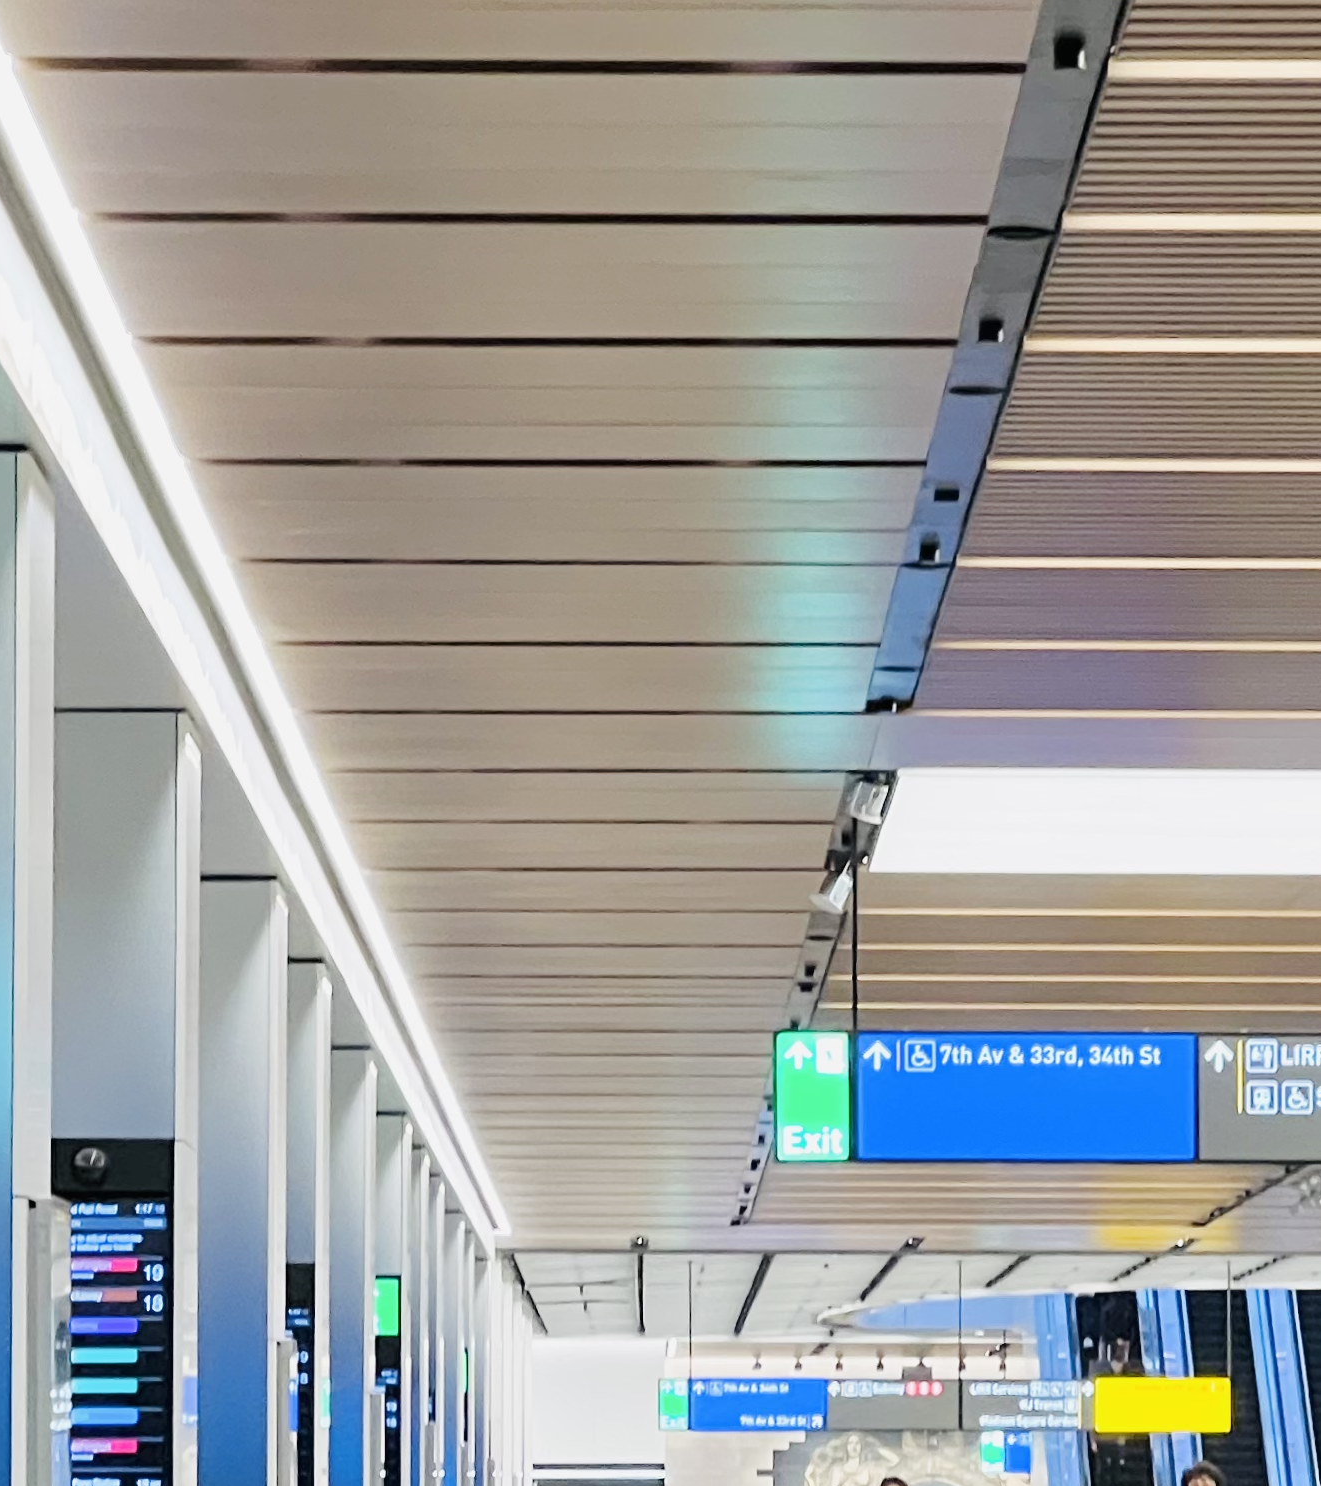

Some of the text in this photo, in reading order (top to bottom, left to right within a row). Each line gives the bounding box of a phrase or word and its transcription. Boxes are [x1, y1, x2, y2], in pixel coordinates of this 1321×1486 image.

[939, 1046, 1162, 1068] 7th Av & 33rd, 34th St
[783, 1127, 843, 1155] Exit
